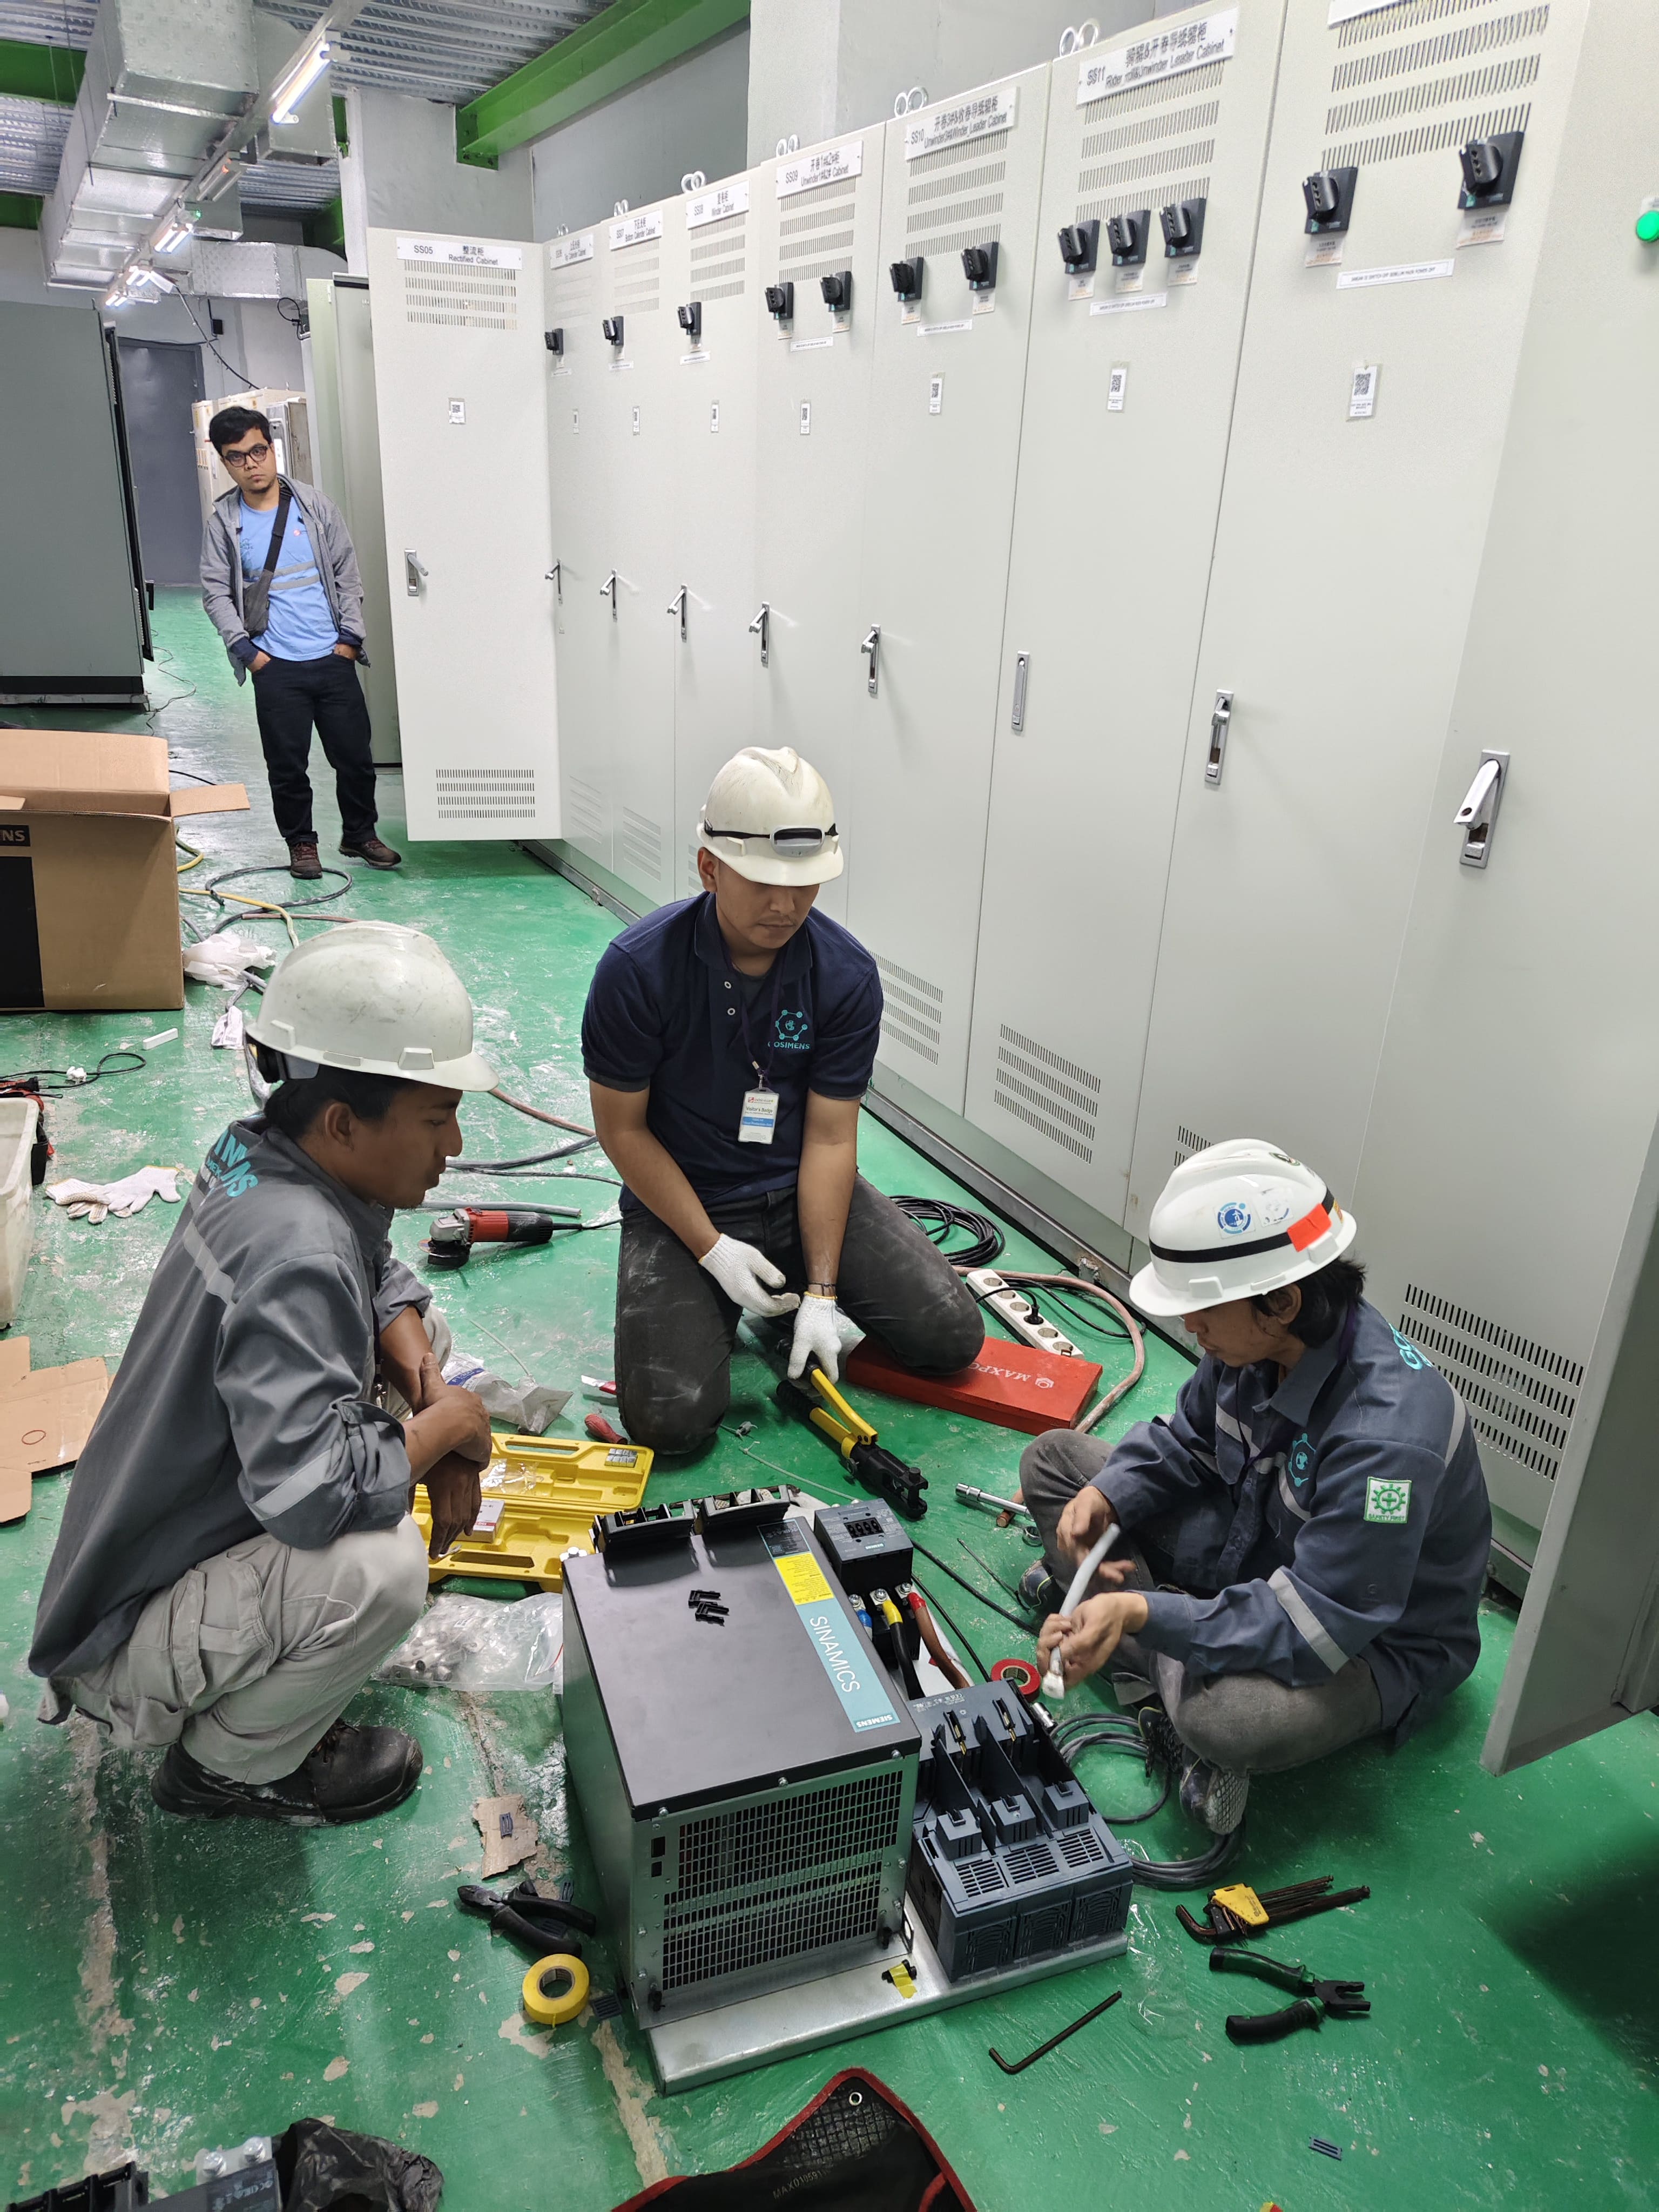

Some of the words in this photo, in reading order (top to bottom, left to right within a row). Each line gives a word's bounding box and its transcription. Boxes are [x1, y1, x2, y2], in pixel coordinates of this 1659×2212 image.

[1170, 50, 1195, 68] Leader
[1196, 39, 1224, 57] Cabinet
[1087, 65, 1105, 86] SS11
[988, 112, 1007, 128] Cabinet
[911, 129, 924, 144] SS10
[786, 170, 798, 184] SS09
[832, 164, 849, 177] Cabinet
[414, 245, 433, 254] SS05
[462, 245, 484, 257] 整流柜
[448, 254, 473, 263] Rectified
[476, 257, 498, 266] Cabinet
[0, 830, 26, 842] NS
[809, 1615, 861, 1693] SINAMICS
[855, 1714, 894, 1729] SIEMENS
